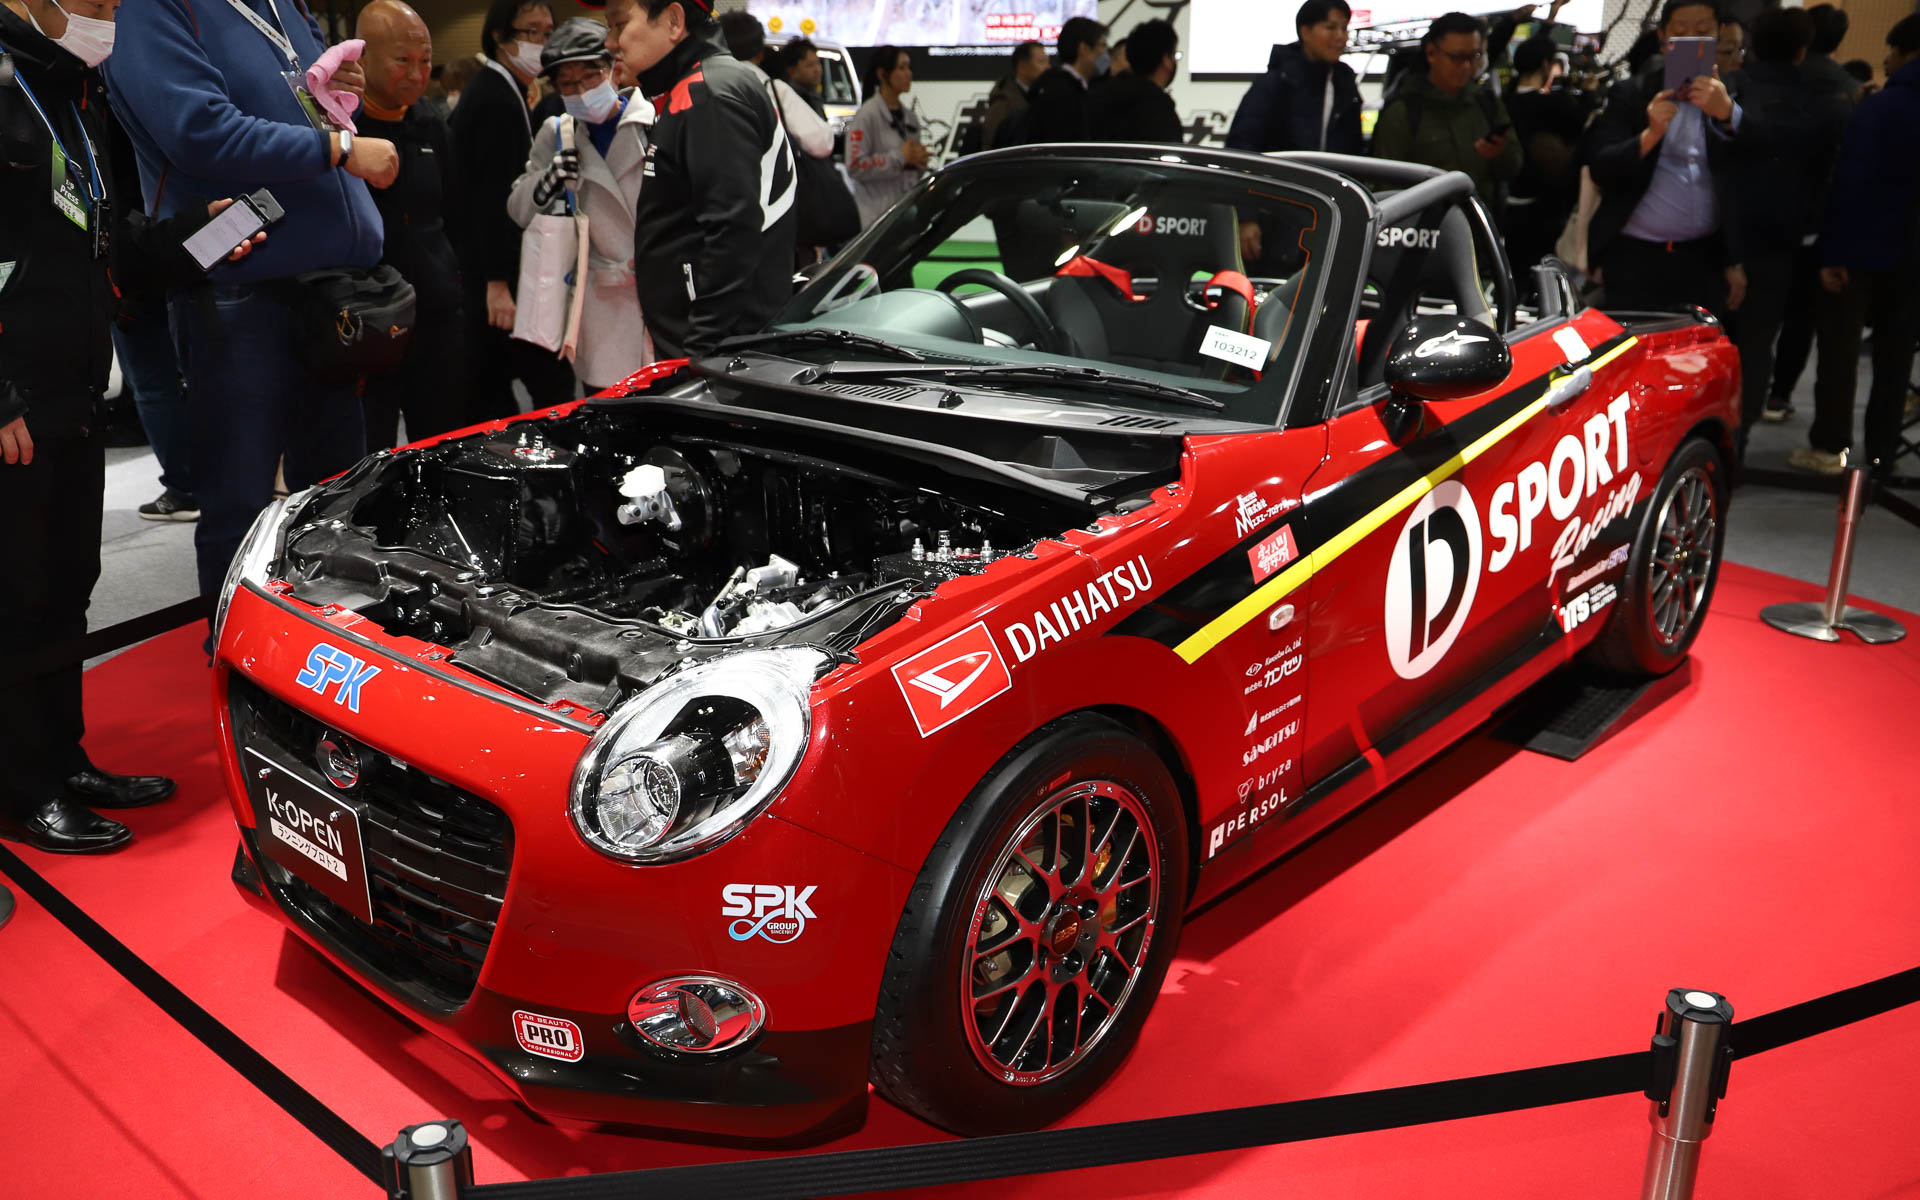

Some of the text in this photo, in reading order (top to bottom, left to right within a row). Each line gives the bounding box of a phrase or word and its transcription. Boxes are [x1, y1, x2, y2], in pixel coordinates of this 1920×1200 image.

[60, 184, 80, 205] Press
[1155, 216, 1207, 236] SPORT
[1376, 227, 1440, 249] SPORT
[1214, 340, 1257, 360] 103212
[1406, 391, 1631, 665] D SPORT
[1547, 471, 1642, 588] Racing
[1004, 554, 1153, 663] DAIHATSU
[296, 642, 383, 714] SPK
[1263, 653, 1303, 689] カンセツ
[1258, 758, 1293, 791] bryza
[265, 786, 344, 857] K-OPEN
[1226, 787, 1289, 837] PERSOL
[722, 883, 819, 919] SPK
[766, 922, 798, 931] GROUP
[518, 1013, 571, 1028] CAR BEAUTY
[526, 1023, 568, 1047] PRO
[527, 1043, 573, 1058] PROFESSIONAL
